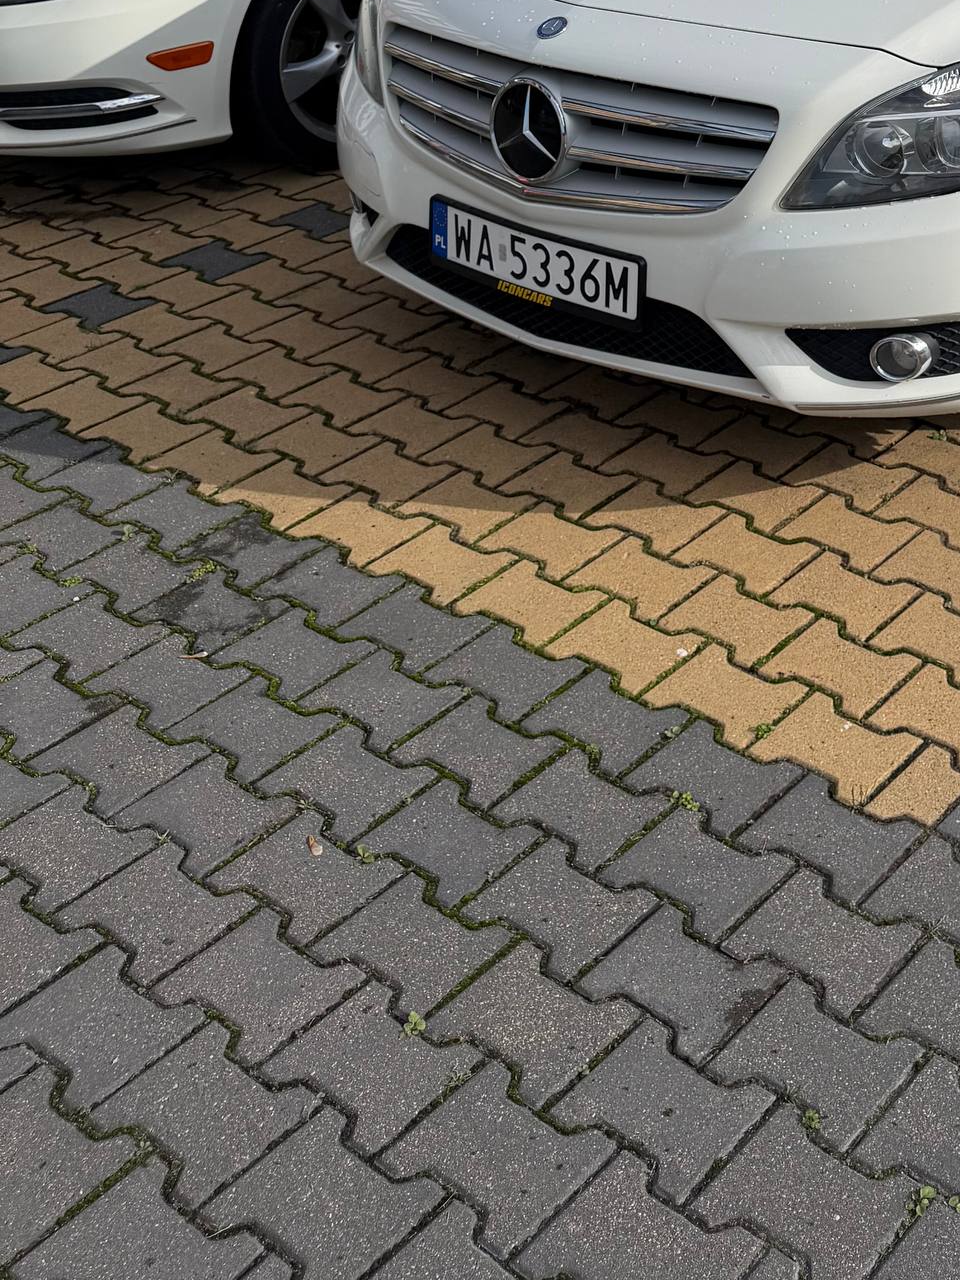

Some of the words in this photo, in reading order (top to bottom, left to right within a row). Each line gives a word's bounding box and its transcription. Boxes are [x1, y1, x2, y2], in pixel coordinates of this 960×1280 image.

[434, 233, 446, 249] PL
[454, 213, 494, 271] WA
[509, 233, 629, 313] 5336M
[496, 279, 554, 308] ICONCARS
